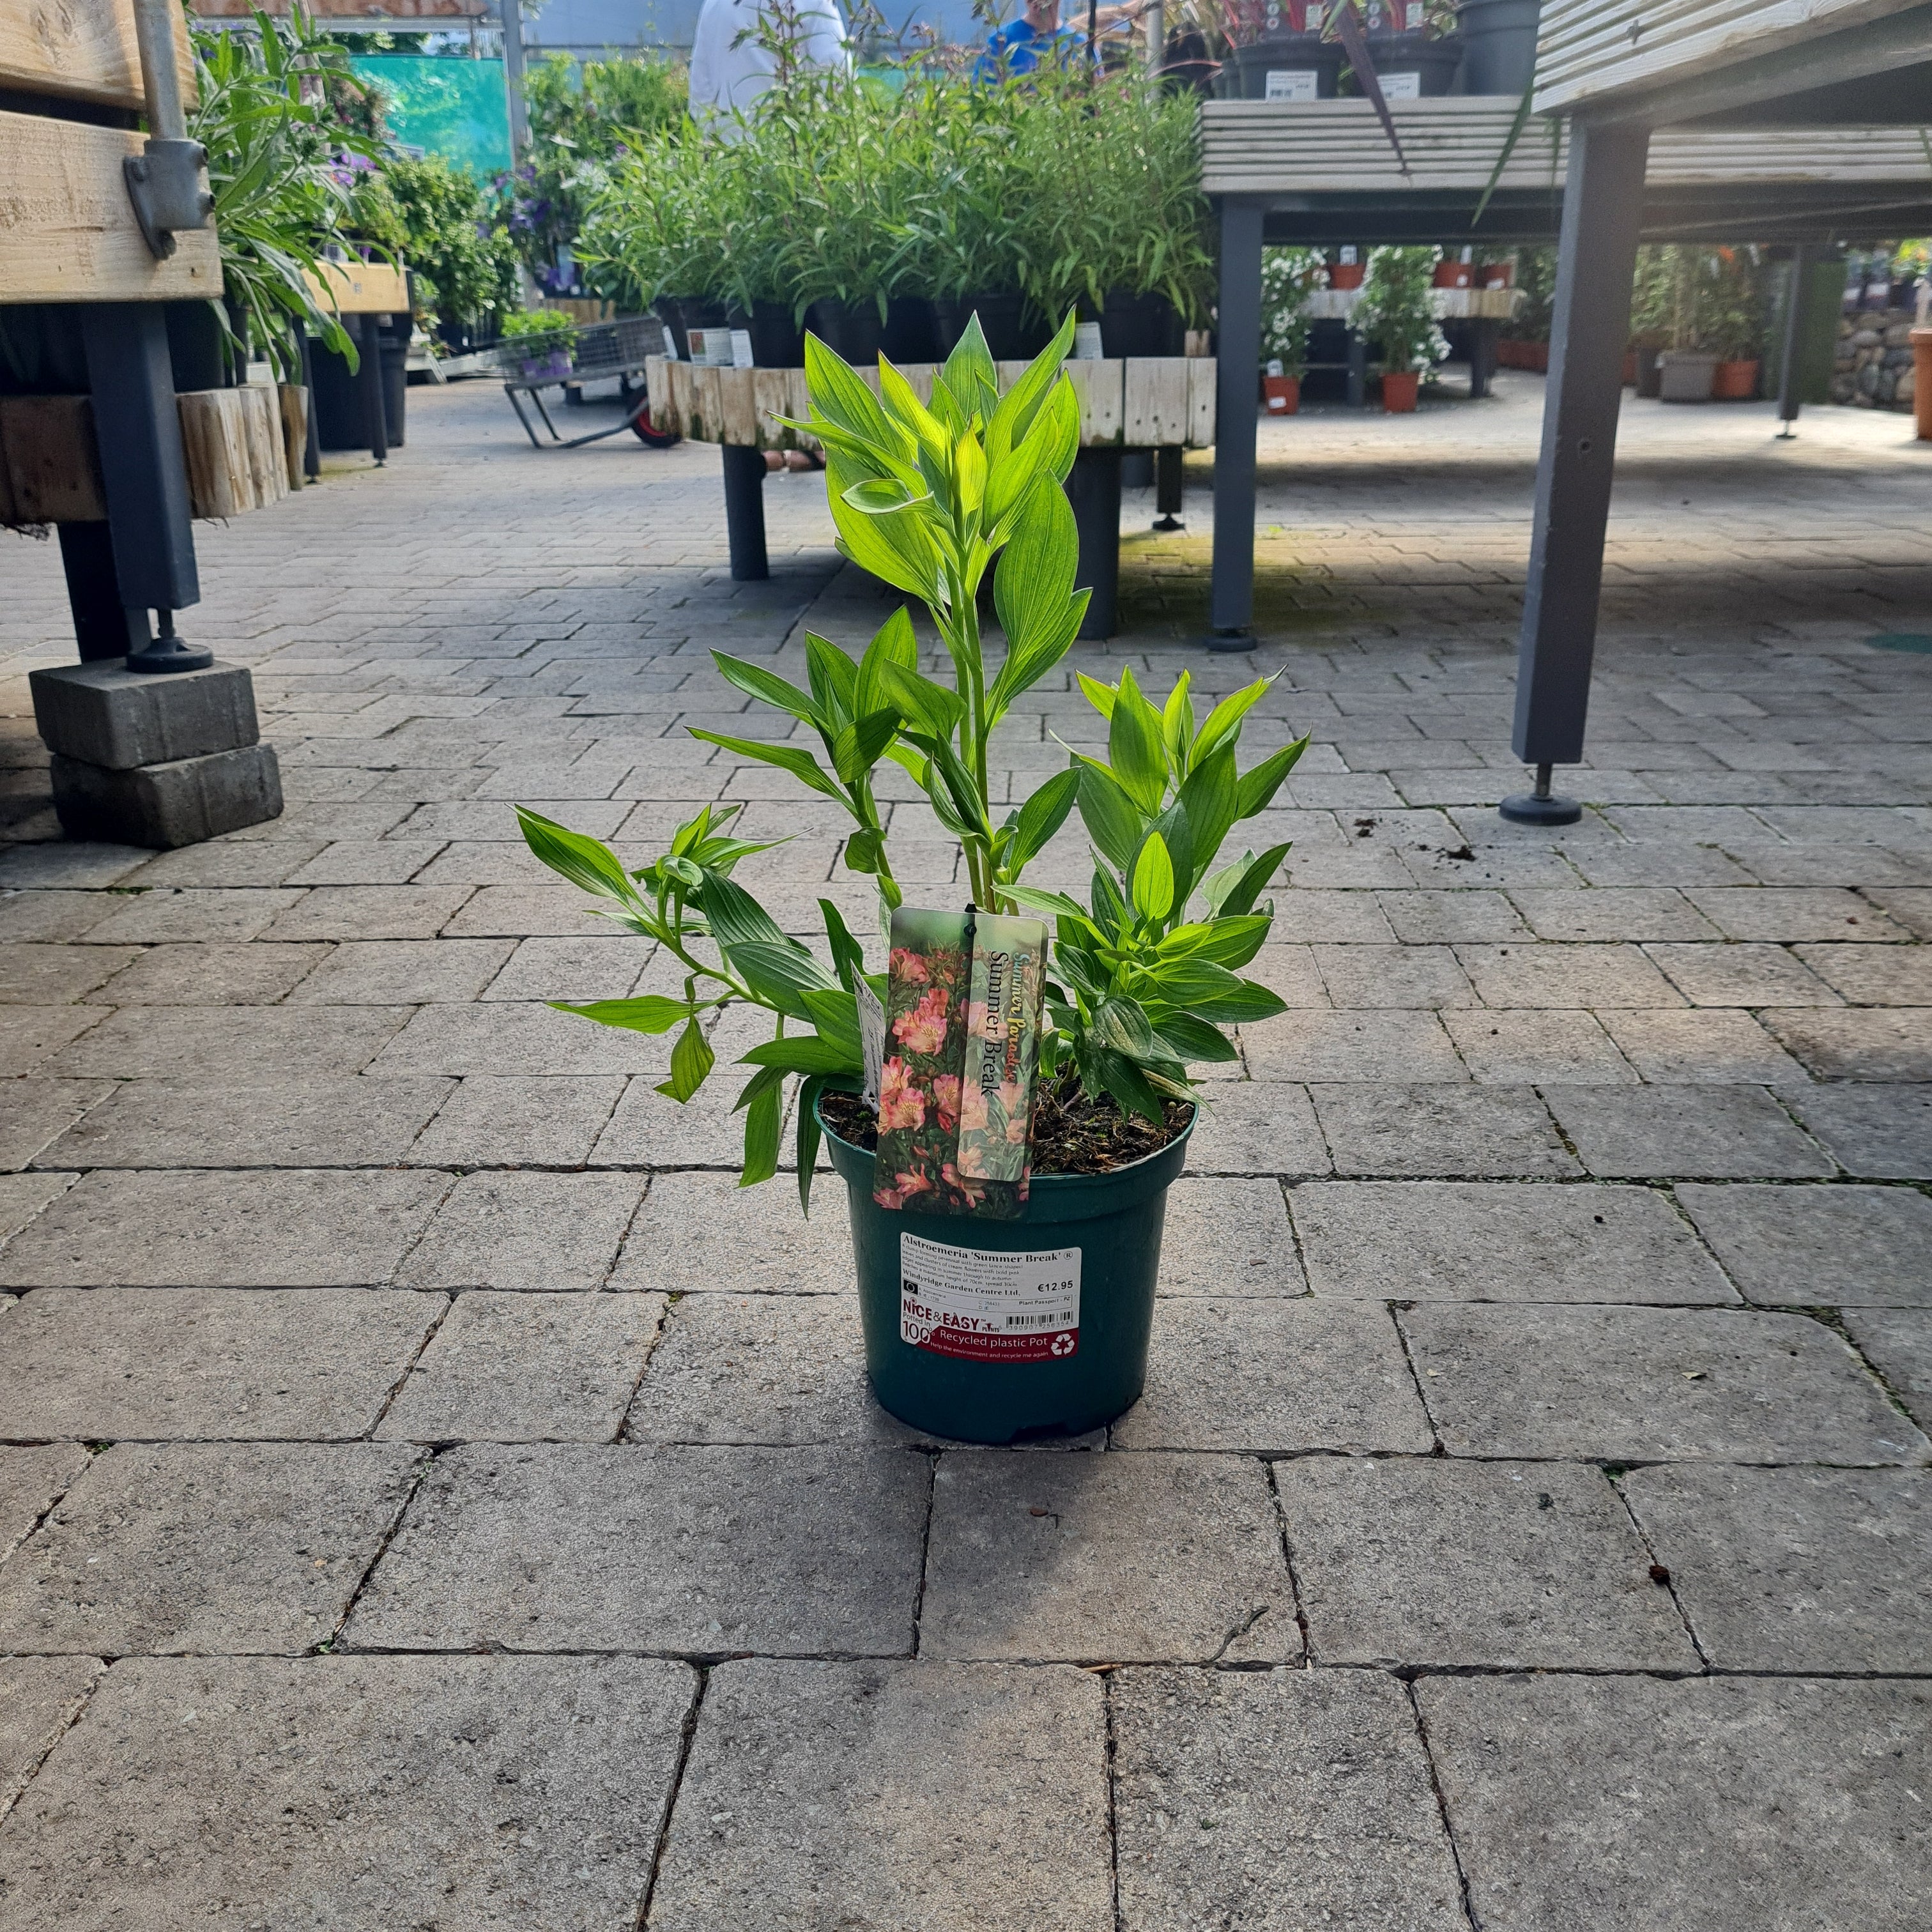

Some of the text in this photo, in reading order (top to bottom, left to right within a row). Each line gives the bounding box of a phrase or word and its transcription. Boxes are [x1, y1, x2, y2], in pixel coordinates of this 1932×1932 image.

[980, 951, 1009, 1097] Summer Break
[1004, 952, 1030, 1084] Summer Paradise
[903, 1235, 968, 1259] Alstroemeria
[971, 1252, 1022, 1262] 'Summer
[1025, 1252, 1061, 1262] Break'
[914, 1261, 937, 1271] appearing
[963, 1272, 984, 1280] through
[924, 1258, 941, 1266] clusters
[903, 1268, 944, 1287] Windyridge
[944, 1282, 973, 1293] Garden
[975, 1287, 1002, 1296] Centre
[1038, 1280, 1073, 1292] €12.95
[903, 1312, 923, 1325] Potted
[940, 1330, 987, 1346] Recycled
[990, 1337, 1027, 1349] plastic
[1030, 1337, 1048, 1347] Pot
[930, 1341, 943, 1350] Help
[953, 1348, 988, 1358] environment
